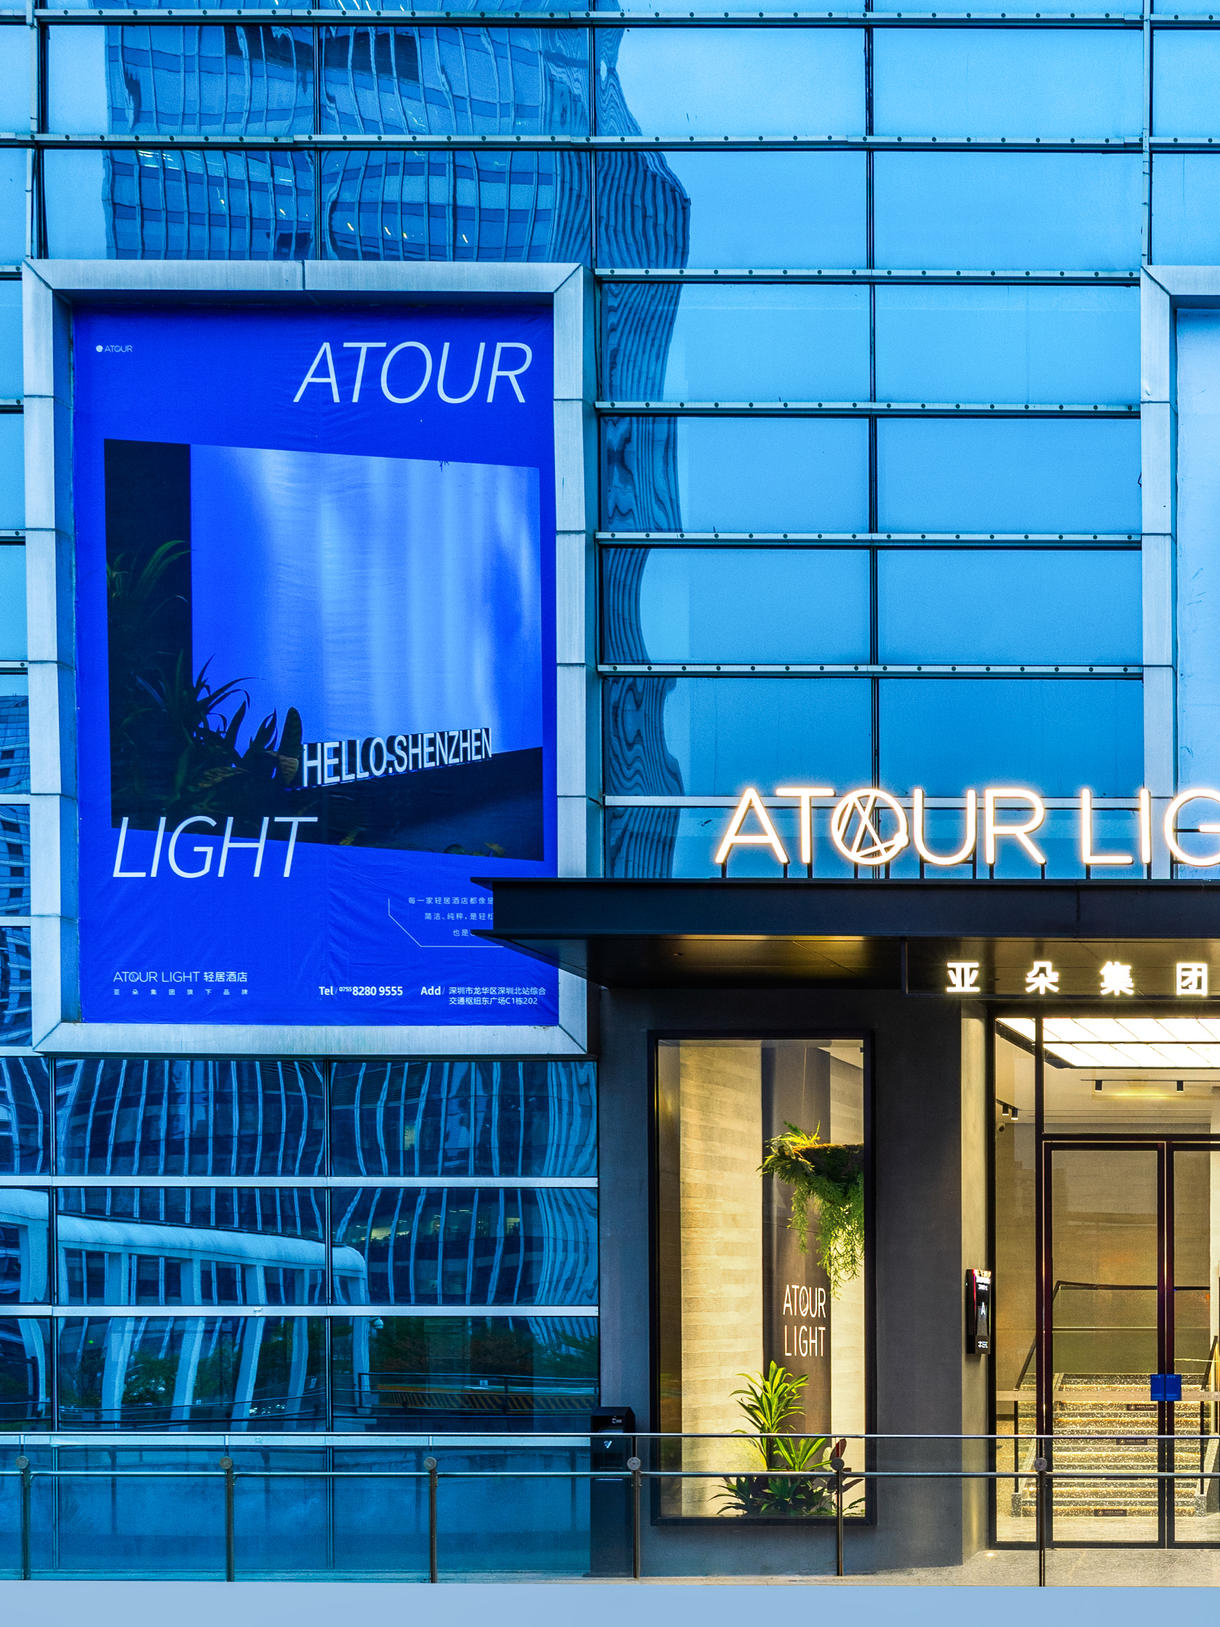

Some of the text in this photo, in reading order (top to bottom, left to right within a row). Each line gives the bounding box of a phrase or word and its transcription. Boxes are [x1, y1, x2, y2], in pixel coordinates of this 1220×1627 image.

[104, 344, 134, 353] ATOUR
[293, 341, 533, 404] ATOUR
[302, 727, 493, 788] HELLO.SHENZHEN
[714, 786, 1046, 868] ATOUR
[112, 815, 319, 879] LIGHT
[113, 971, 248, 983] ATOUR LIGHT 轻居酒店
[378, 986, 403, 996] 9555
[782, 1284, 826, 1318] ATOUR
[783, 1325, 826, 1357] LIGHT
